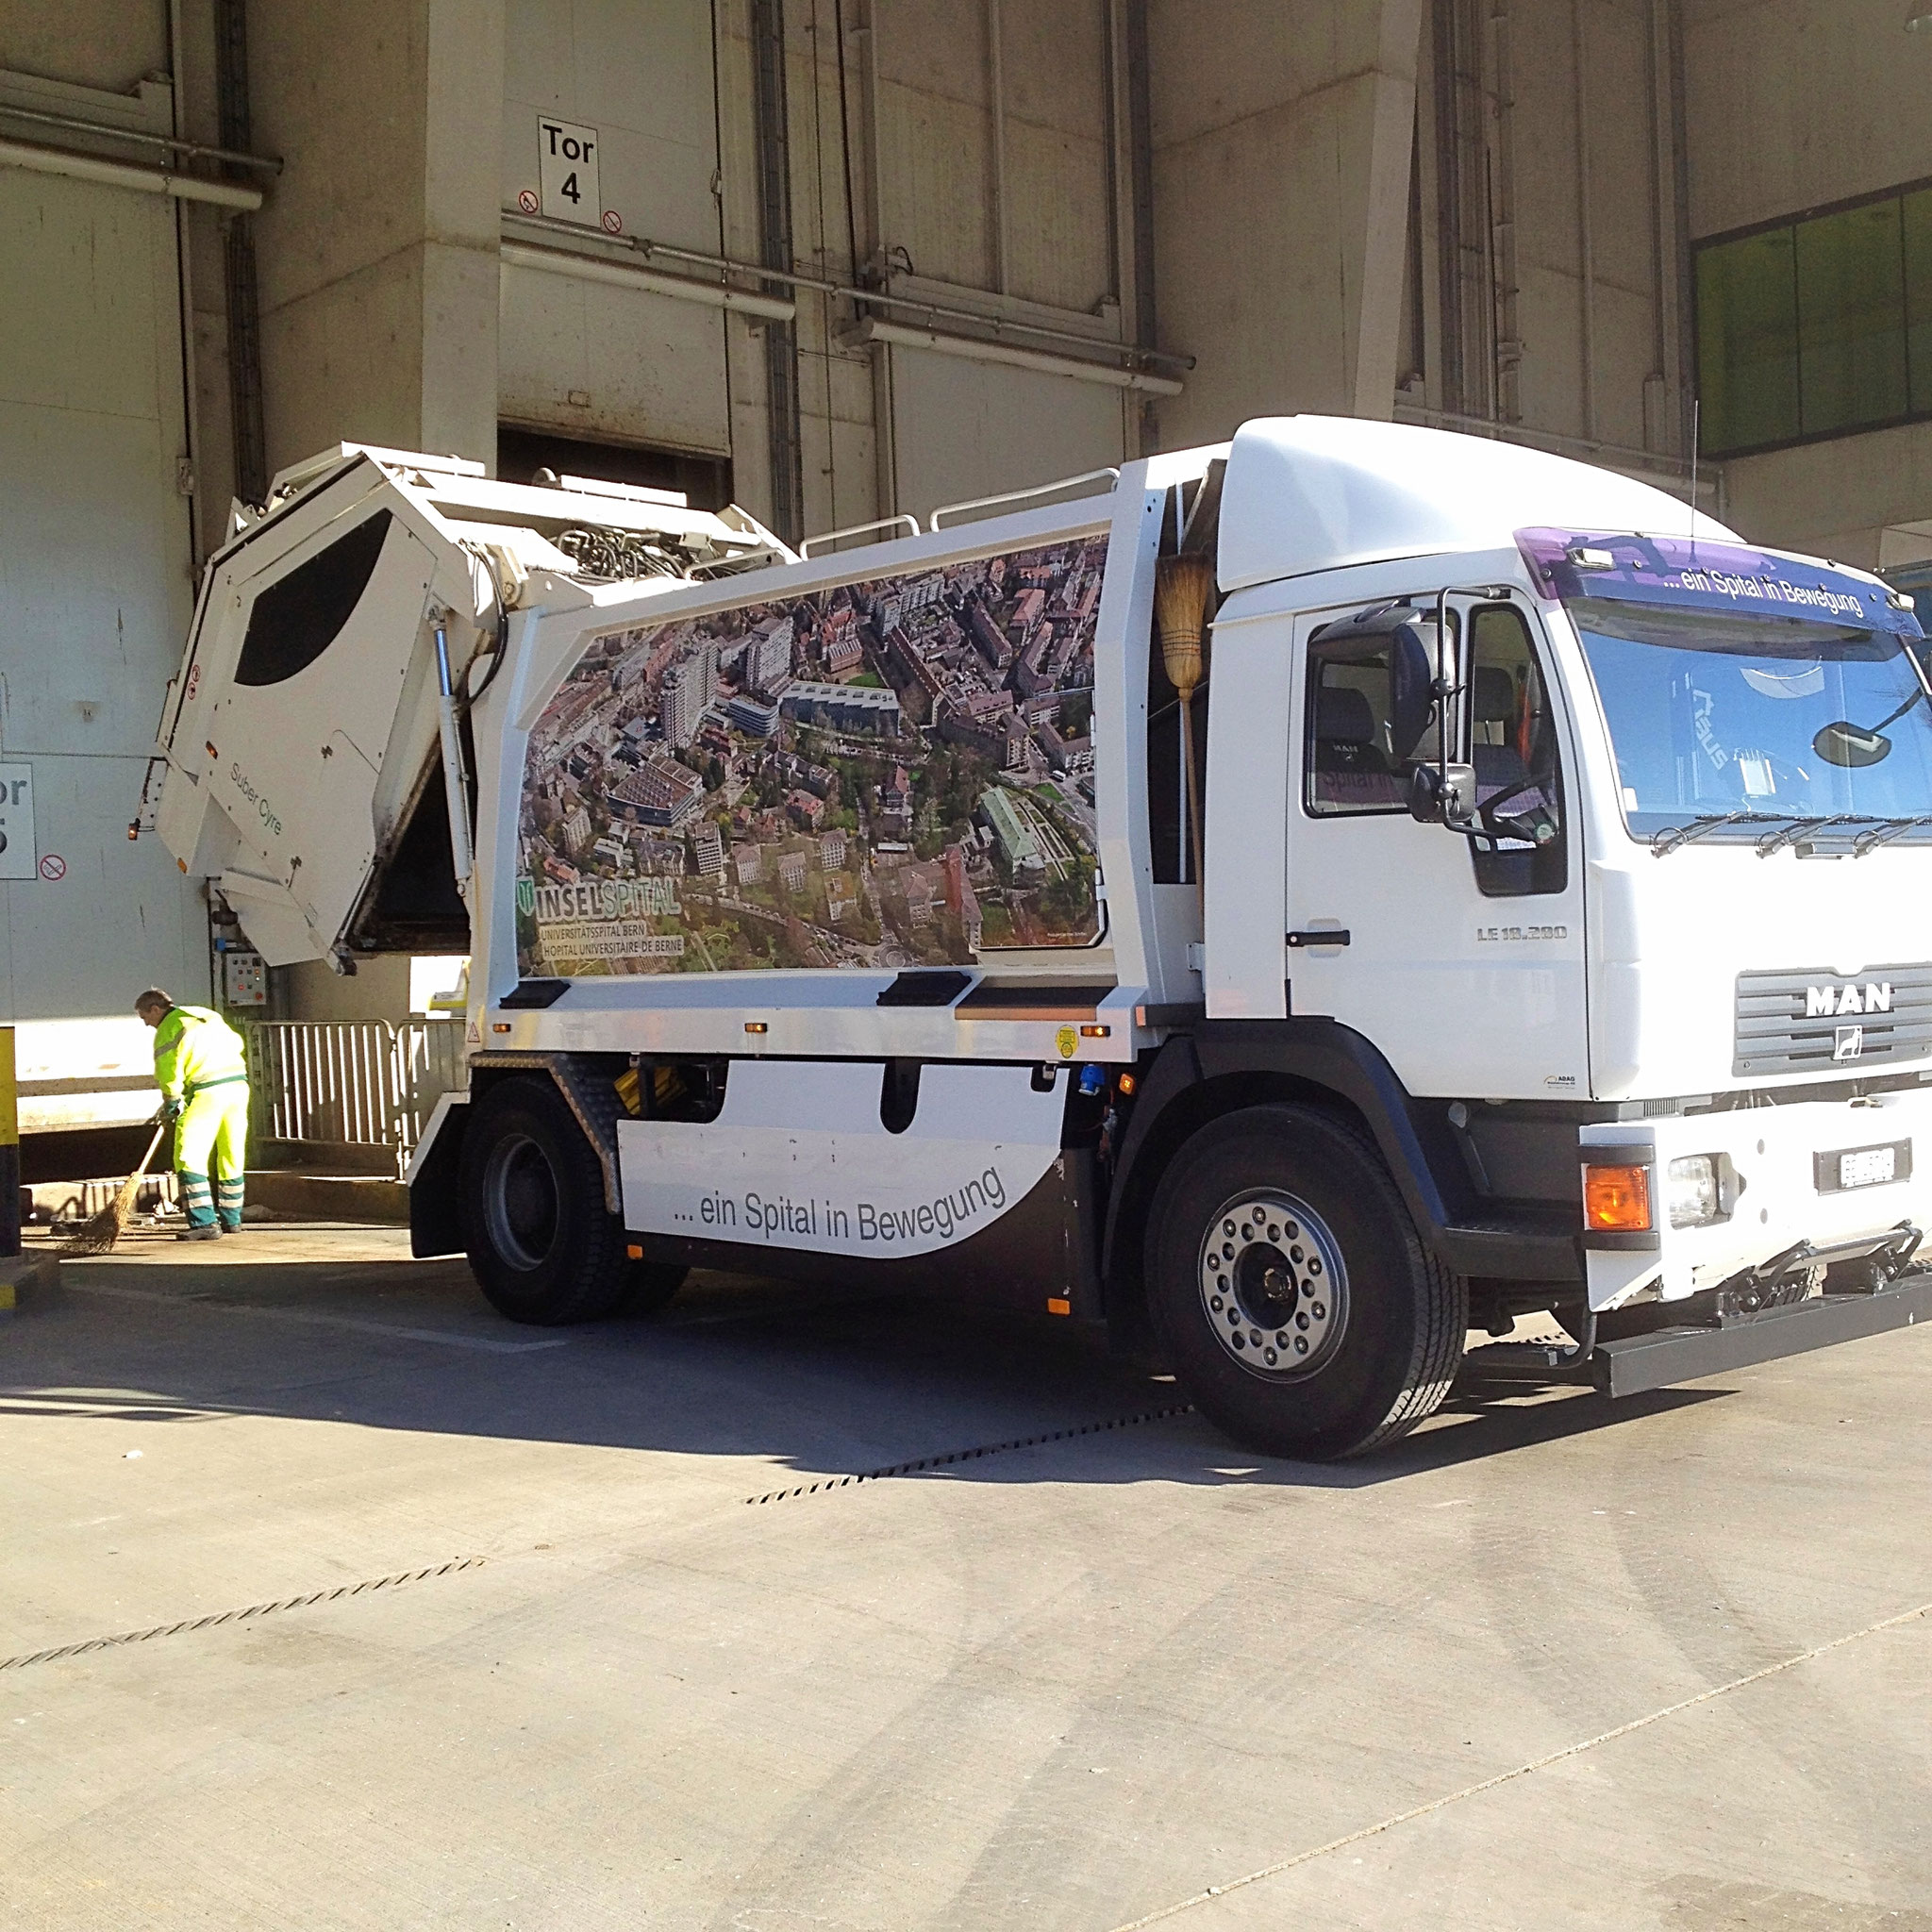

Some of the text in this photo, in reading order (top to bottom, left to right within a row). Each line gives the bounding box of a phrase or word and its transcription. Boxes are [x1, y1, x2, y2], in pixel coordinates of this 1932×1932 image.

[542, 124, 594, 163] Tor
[561, 172, 581, 205] 4
[1710, 570, 1763, 600] Spital
[1760, 576, 1782, 600] in
[1780, 580, 1864, 619] Bewegung
[230, 762, 282, 836] Suber Cyre
[536, 878, 679, 920] INSELSPITAL
[543, 939, 682, 958] HOPITAL UNIVERSITAIRE DE BERNE
[623, 924, 645, 937] BERN
[1477, 925, 1567, 941] LE 18.280
[1807, 982, 1890, 1016] MAN
[745, 1192, 816, 1239] Spital
[825, 1200, 849, 1238] in
[858, 1167, 1007, 1241] Bewegung
